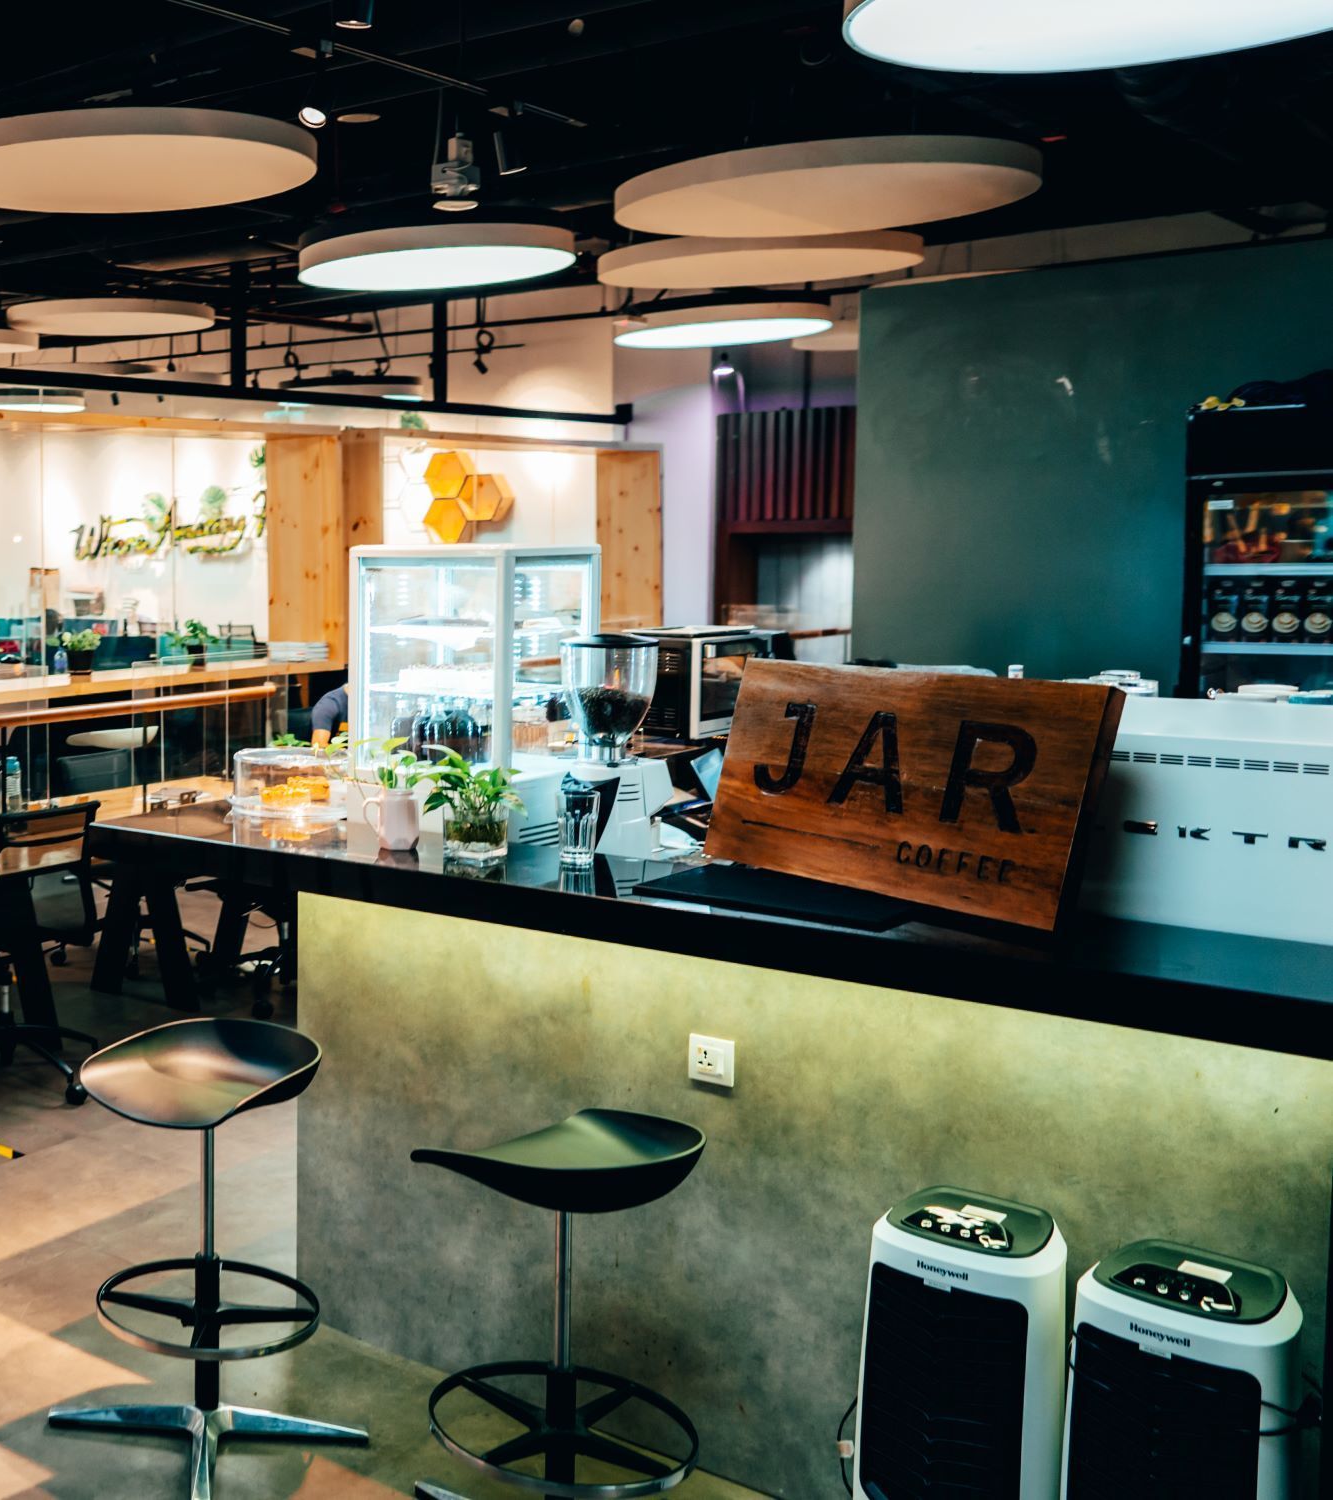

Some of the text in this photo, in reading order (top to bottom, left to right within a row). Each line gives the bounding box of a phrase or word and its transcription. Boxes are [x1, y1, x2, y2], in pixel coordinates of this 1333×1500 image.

[754, 702, 1038, 835] JAR
[896, 840, 1017, 884] COFFEE
[916, 1259, 969, 1281] Honeywell
[1129, 1322, 1191, 1348] Honeywell
